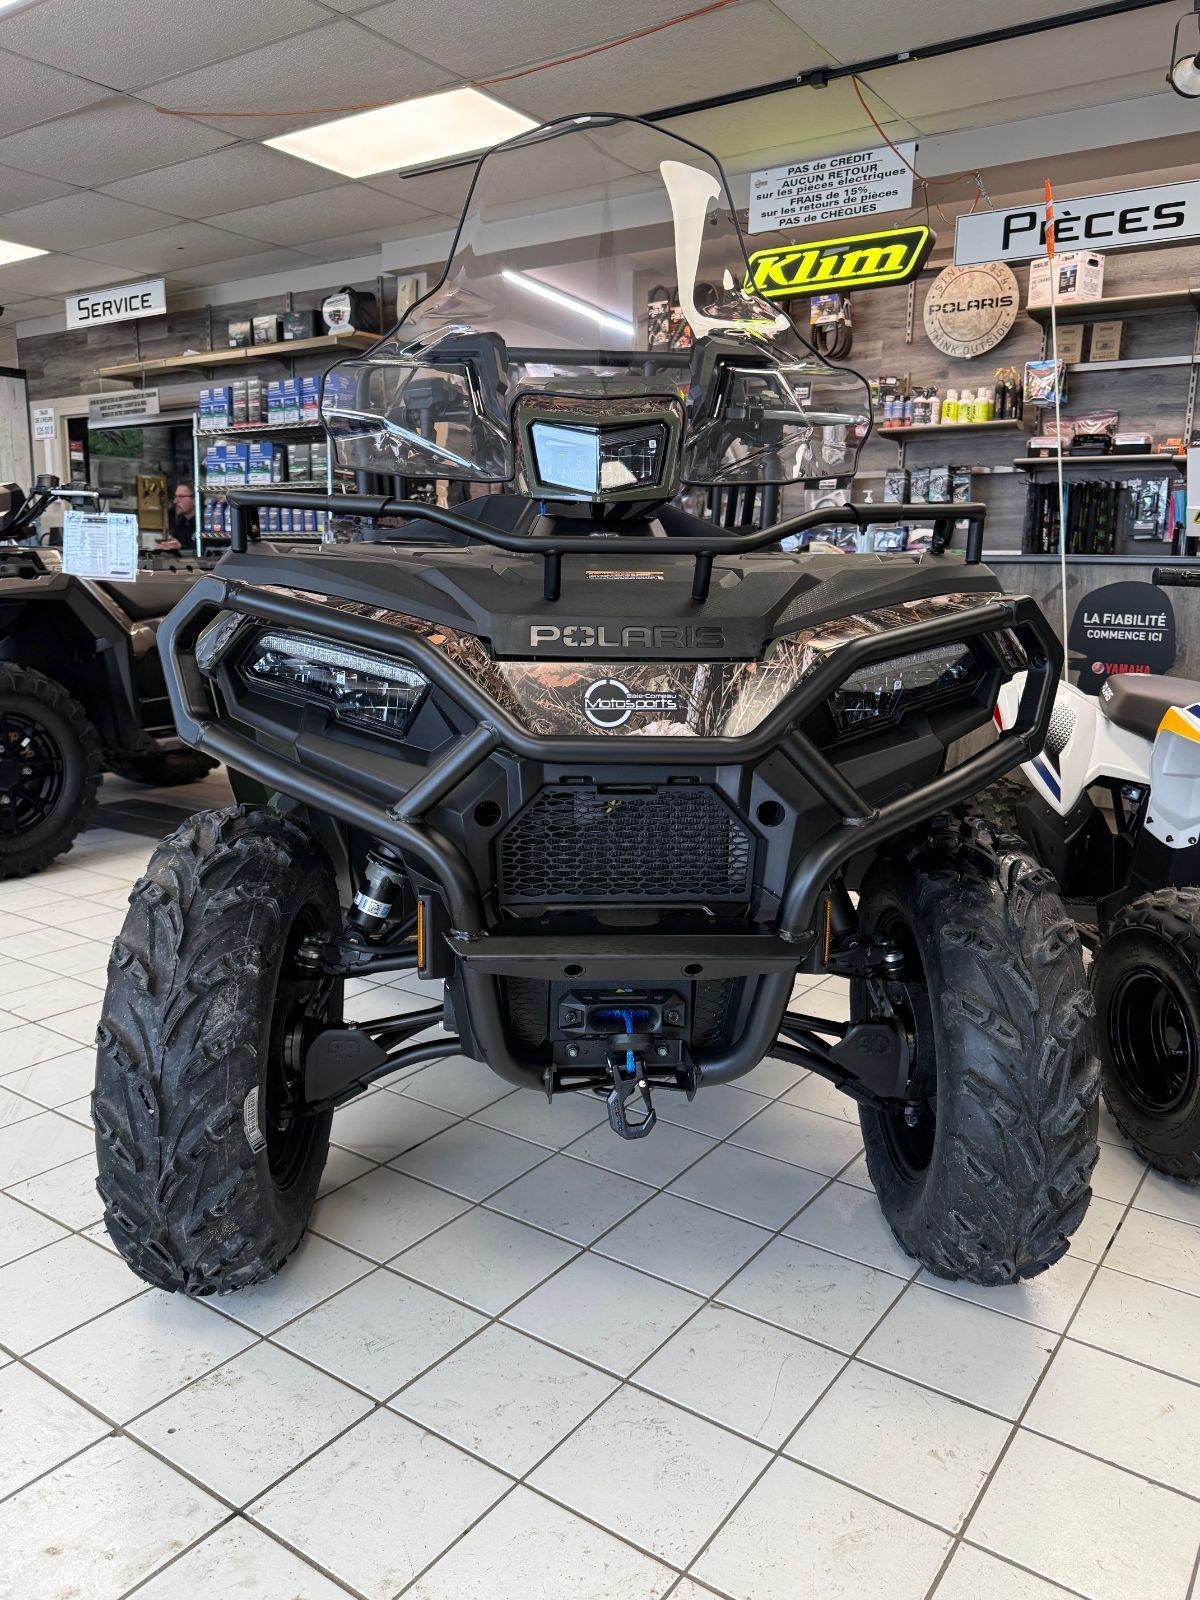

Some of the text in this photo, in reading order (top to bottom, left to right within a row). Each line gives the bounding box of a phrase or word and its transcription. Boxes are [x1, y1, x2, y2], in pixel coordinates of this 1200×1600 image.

[787, 165, 809, 176] PAS
[830, 152, 874, 168] CRÉDIT
[756, 168, 906, 200] sur les pièces électriques
[782, 164, 878, 188] AUCUN RETOUR
[760, 188, 899, 218] sur les retours de pièces
[790, 186, 868, 206] FRAIS de 15%
[778, 216, 800, 226] PAS
[804, 214, 817, 223] de
[78, 292, 152, 320] SERVICE
[928, 296, 1013, 316] POLARIS
[930, 321, 1012, 354] THINK OUTSIDE
[1084, 612, 1166, 626] LA FIABILITÉ
[530, 624, 726, 649] POLARIS
[1086, 630, 1162, 642] COMMENCE ICI
[1105, 662, 1151, 674] YAMAHA
[584, 698, 677, 710] Motosports
